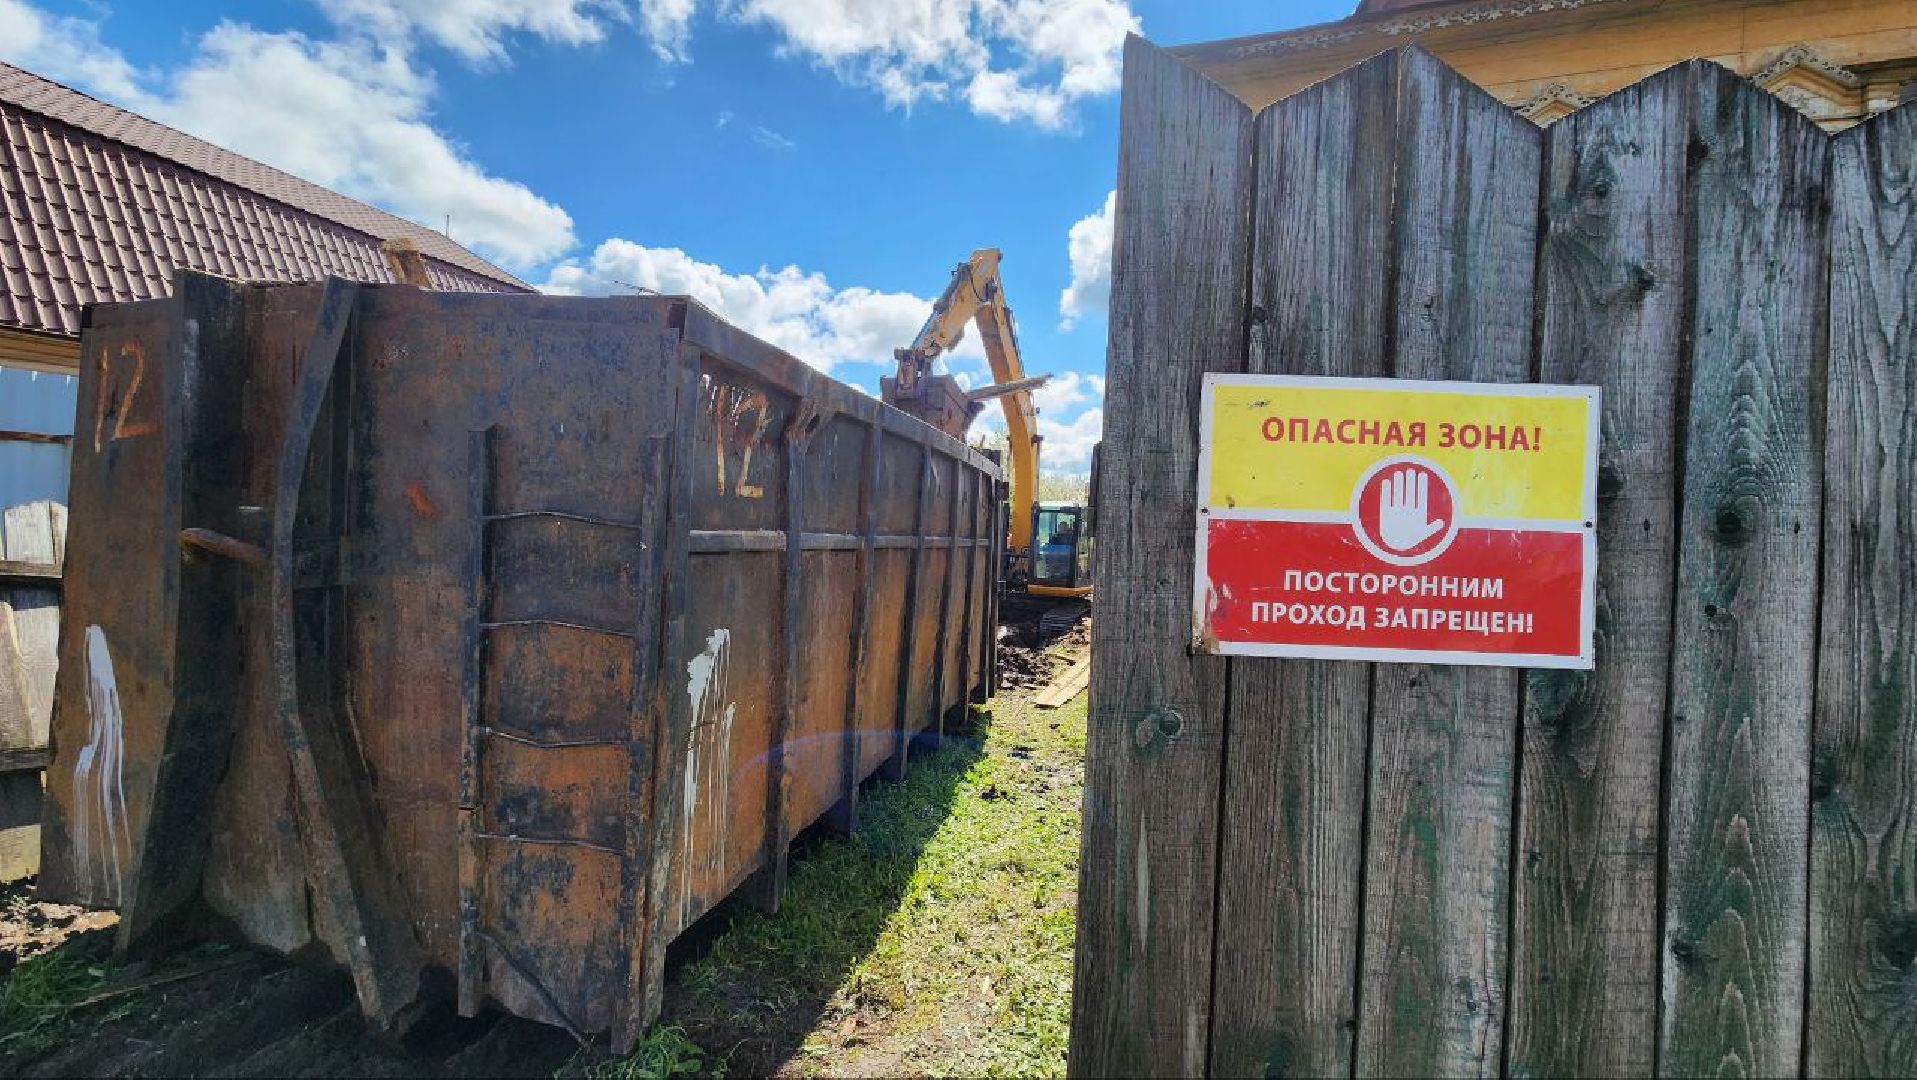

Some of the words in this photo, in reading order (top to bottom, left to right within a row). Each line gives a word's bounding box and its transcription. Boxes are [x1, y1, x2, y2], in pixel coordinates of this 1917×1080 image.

[94, 340, 159, 453] 12
[714, 384, 769, 498] 12
[1262, 416, 1427, 446] ОПАСНАЯ
[1438, 424, 1542, 451] ЗОНА!
[1284, 570, 1504, 599] ПОСТОРОННИМ
[1251, 602, 1366, 630] ПРОХОД
[1374, 608, 1534, 635] ЗАПРЕЩЕН!
